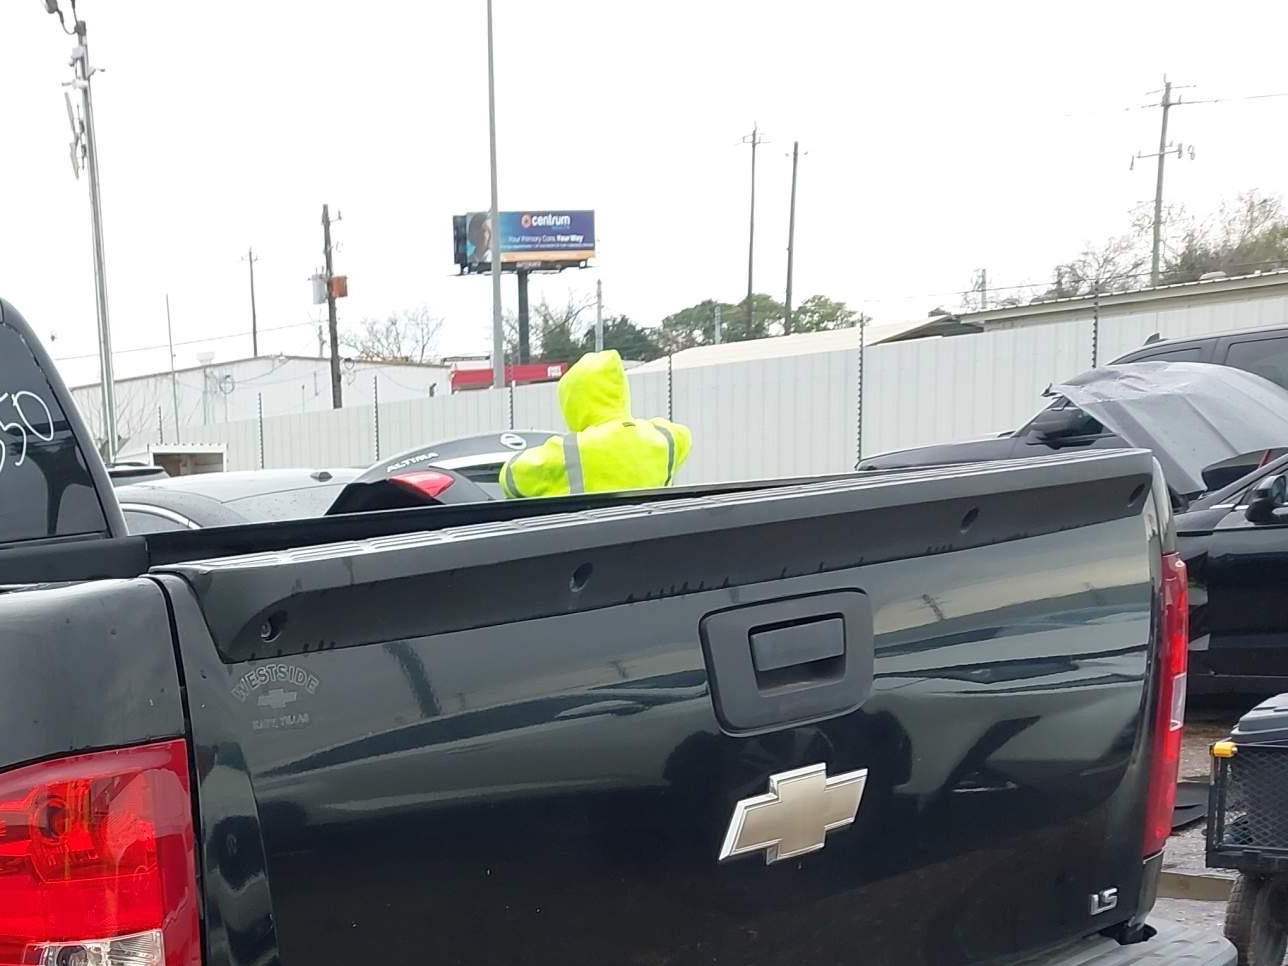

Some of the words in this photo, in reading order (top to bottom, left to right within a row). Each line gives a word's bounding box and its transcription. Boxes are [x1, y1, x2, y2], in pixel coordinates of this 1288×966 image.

[532, 214, 570, 226] centrum
[386, 452, 439, 473] ALTIMA
[231, 663, 320, 703] WESTSIDE
[1090, 887, 1118, 915] LS
